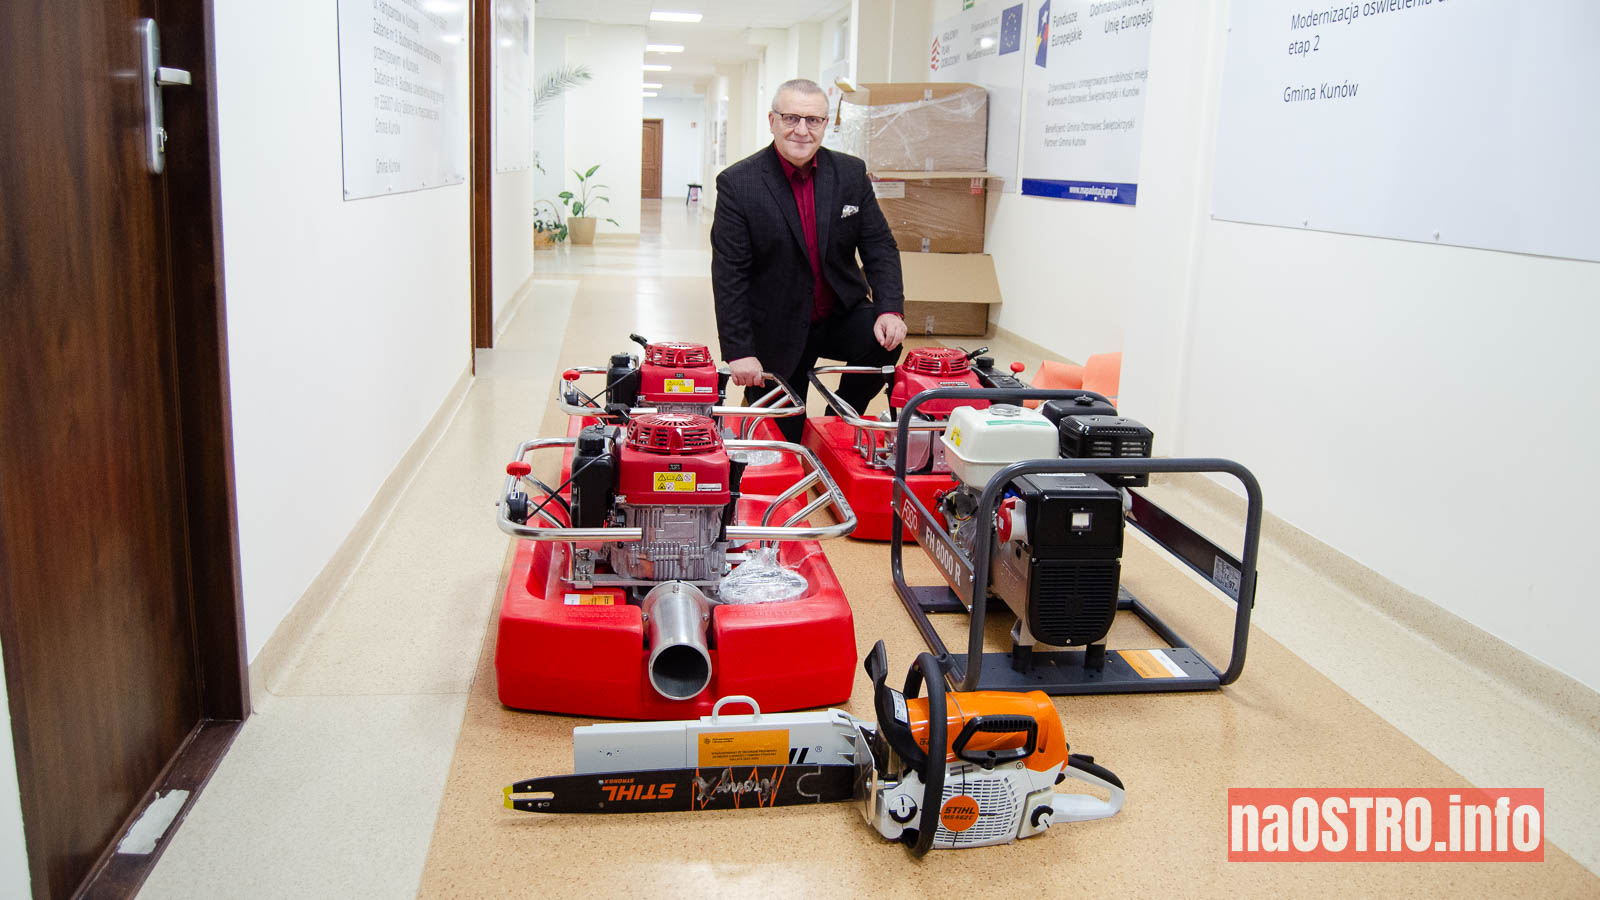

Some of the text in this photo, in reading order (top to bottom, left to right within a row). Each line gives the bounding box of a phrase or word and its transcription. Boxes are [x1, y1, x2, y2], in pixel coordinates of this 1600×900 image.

[1053, 11, 1078, 28] Fundusze
[1104, 14, 1121, 35] Unię
[1291, 2, 1359, 31] Modernizacja
[1051, 26, 1083, 48] Europejskie
[1288, 34, 1320, 58] etap 2
[1283, 79, 1359, 103] Gmina Kunów
[925, 525, 935, 553] FH
[936, 539, 954, 576] 8000
[601, 783, 677, 801] STIHL
[943, 806, 976, 815] STIHL
